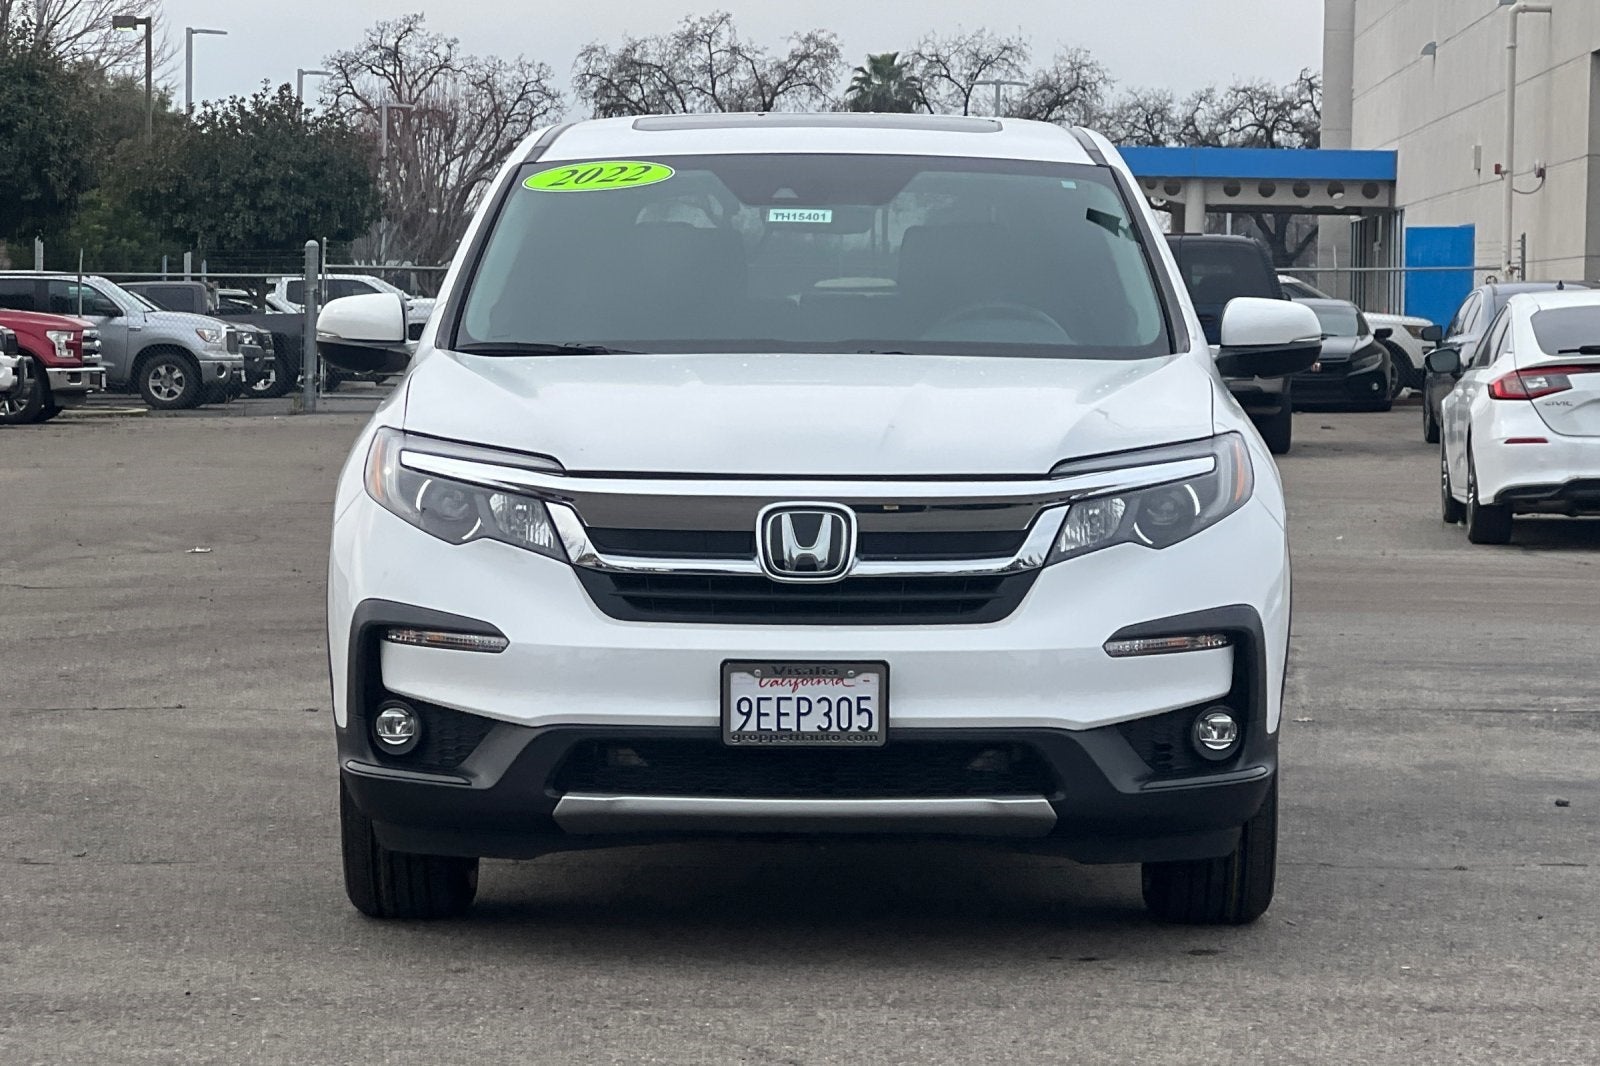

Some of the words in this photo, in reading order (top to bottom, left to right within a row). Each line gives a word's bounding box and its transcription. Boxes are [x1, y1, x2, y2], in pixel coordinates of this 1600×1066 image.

[547, 165, 652, 187] 2022
[774, 212, 826, 221] TH15401
[771, 665, 839, 675] Visalia
[759, 677, 855, 693] California
[736, 696, 873, 732] 9EEP305
[731, 731, 878, 743] groppettiauto.com
